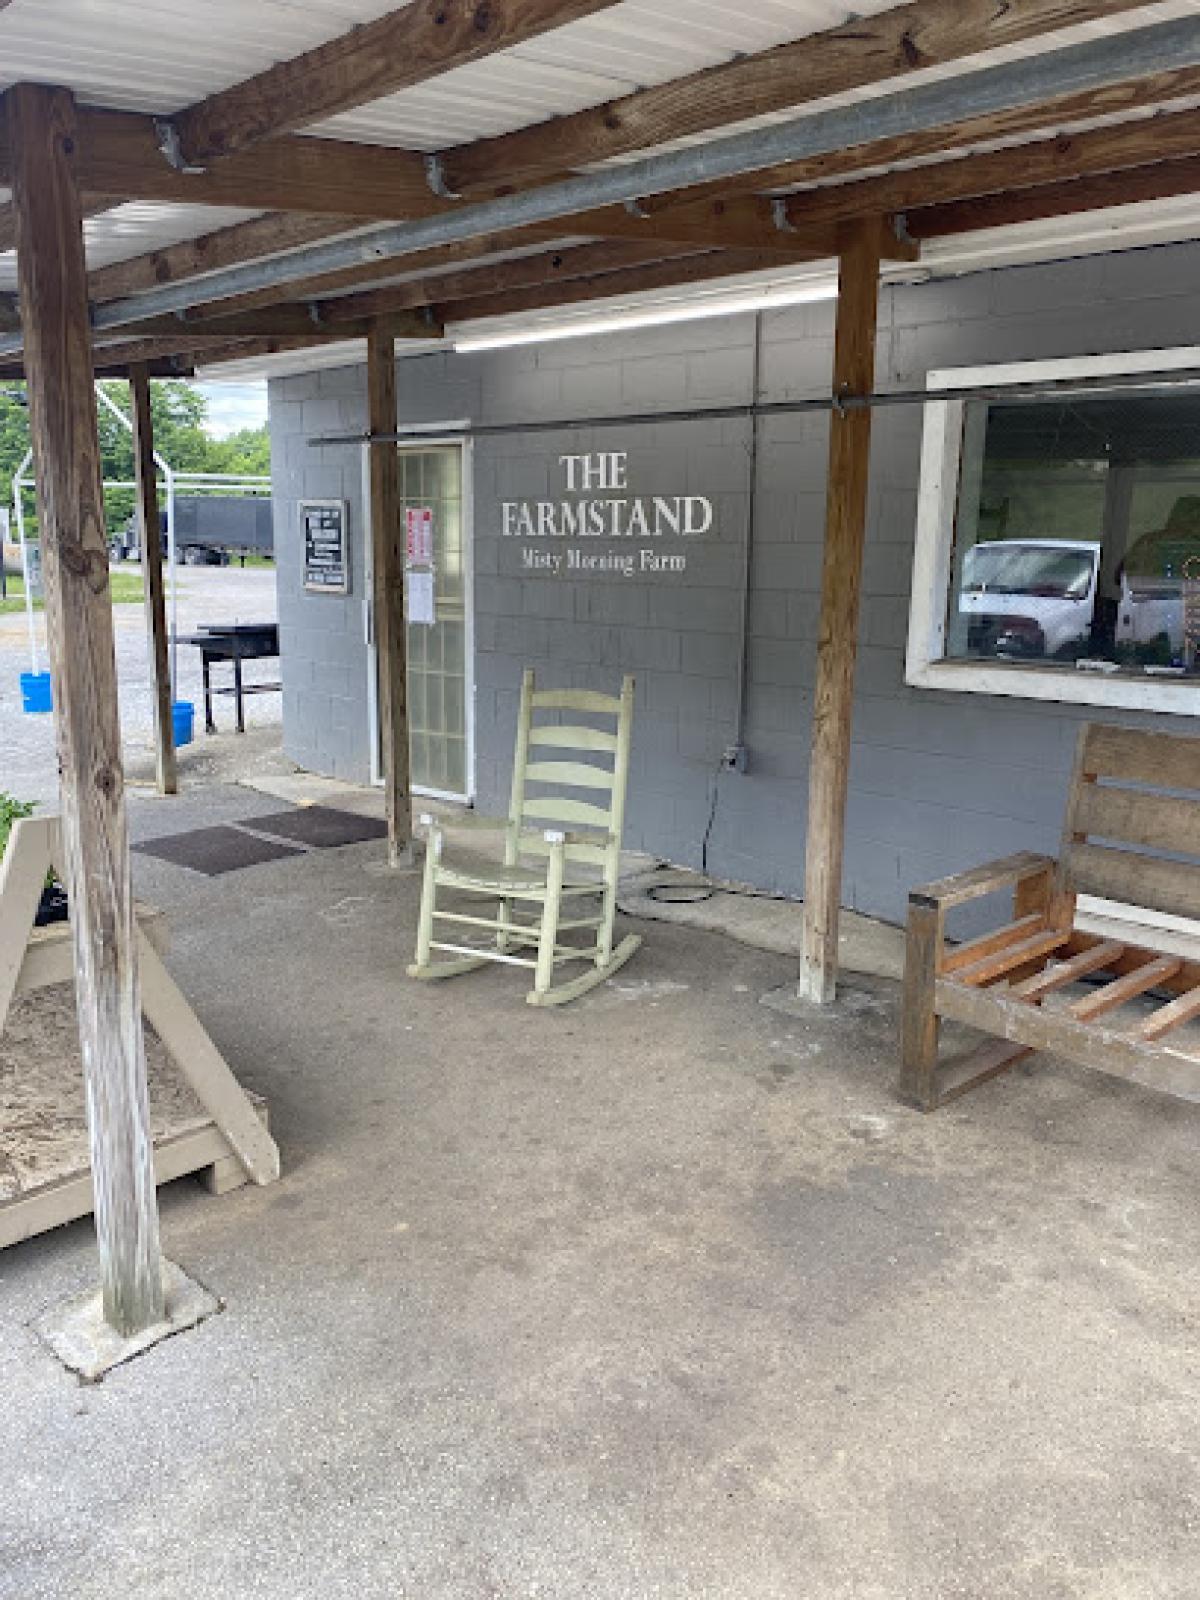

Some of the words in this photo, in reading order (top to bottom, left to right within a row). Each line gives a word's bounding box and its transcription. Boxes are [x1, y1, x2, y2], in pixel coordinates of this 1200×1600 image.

[558, 452, 628, 491] THE
[502, 496, 713, 537] FARMSTAND
[522, 548, 562, 575] Misty
[566, 549, 634, 577] Morning
[640, 550, 687, 572] Farm
